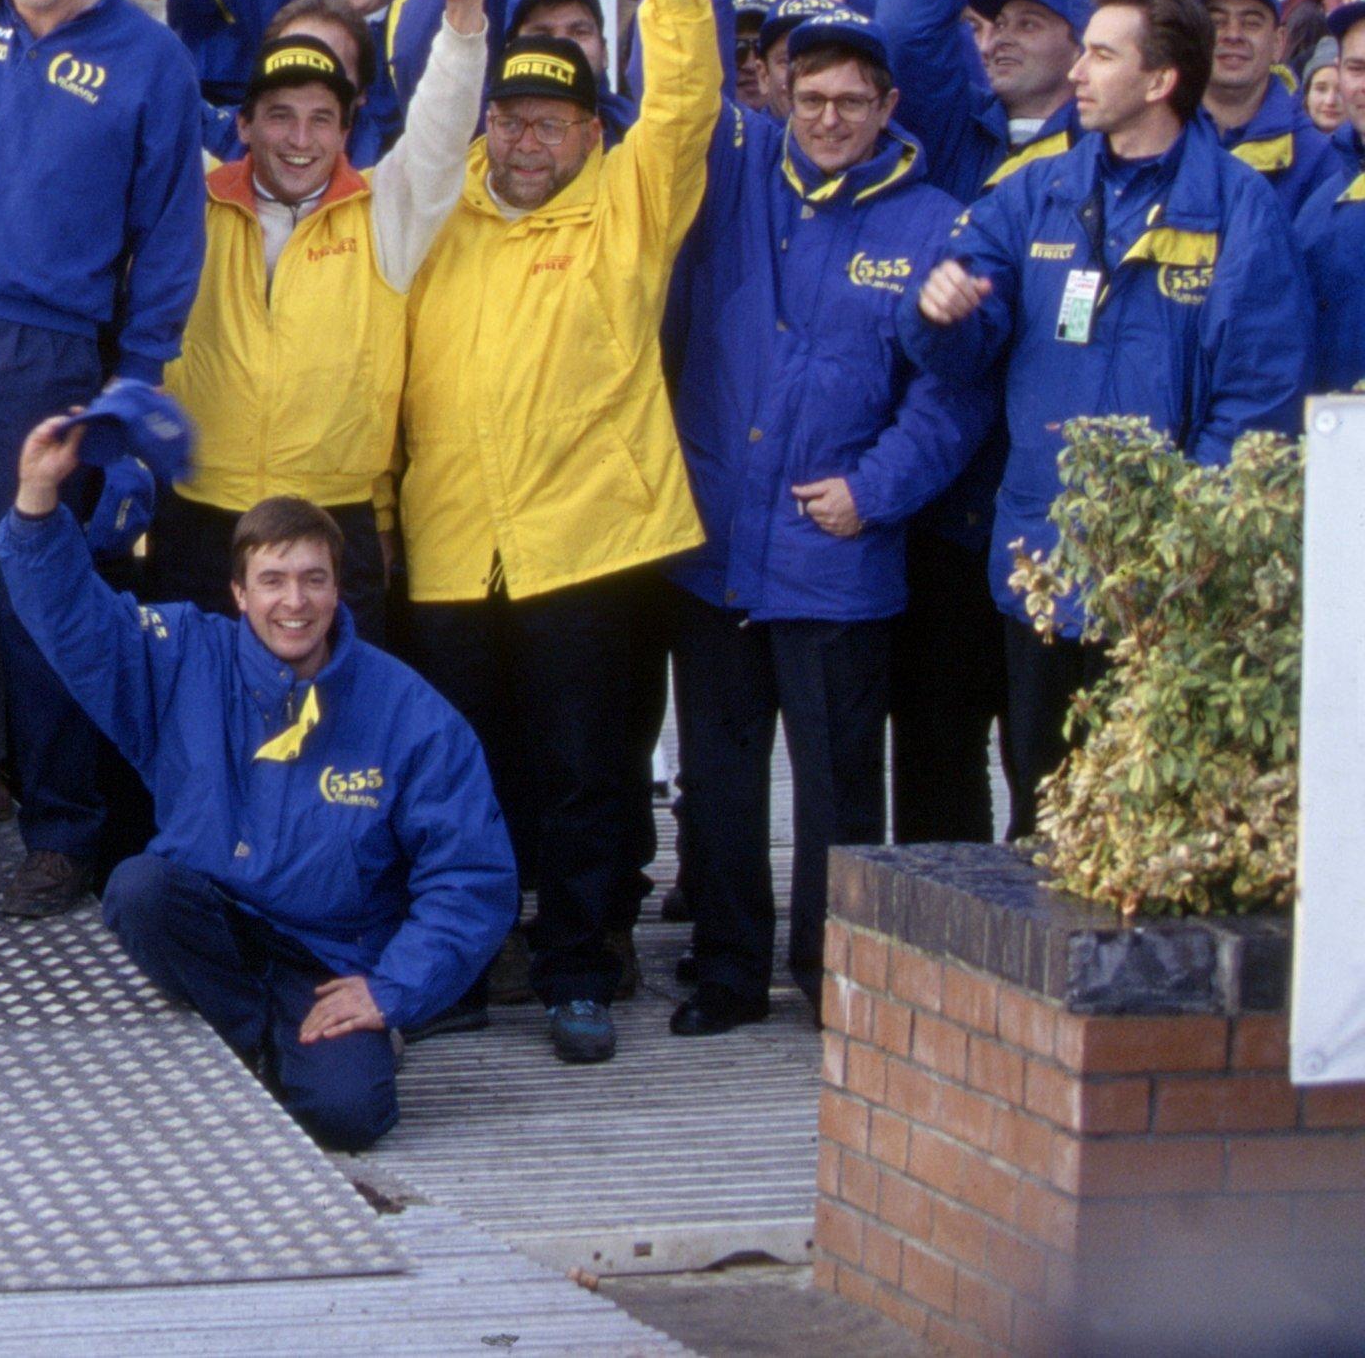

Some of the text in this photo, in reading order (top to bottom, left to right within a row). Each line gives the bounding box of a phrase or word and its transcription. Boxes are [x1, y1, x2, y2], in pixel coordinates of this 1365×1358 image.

[265, 47, 335, 76] PIRELLI
[502, 53, 576, 87] PIRELLI
[859, 257, 913, 279] 555
[1168, 266, 1214, 290] 555
[329, 768, 384, 793] 555
